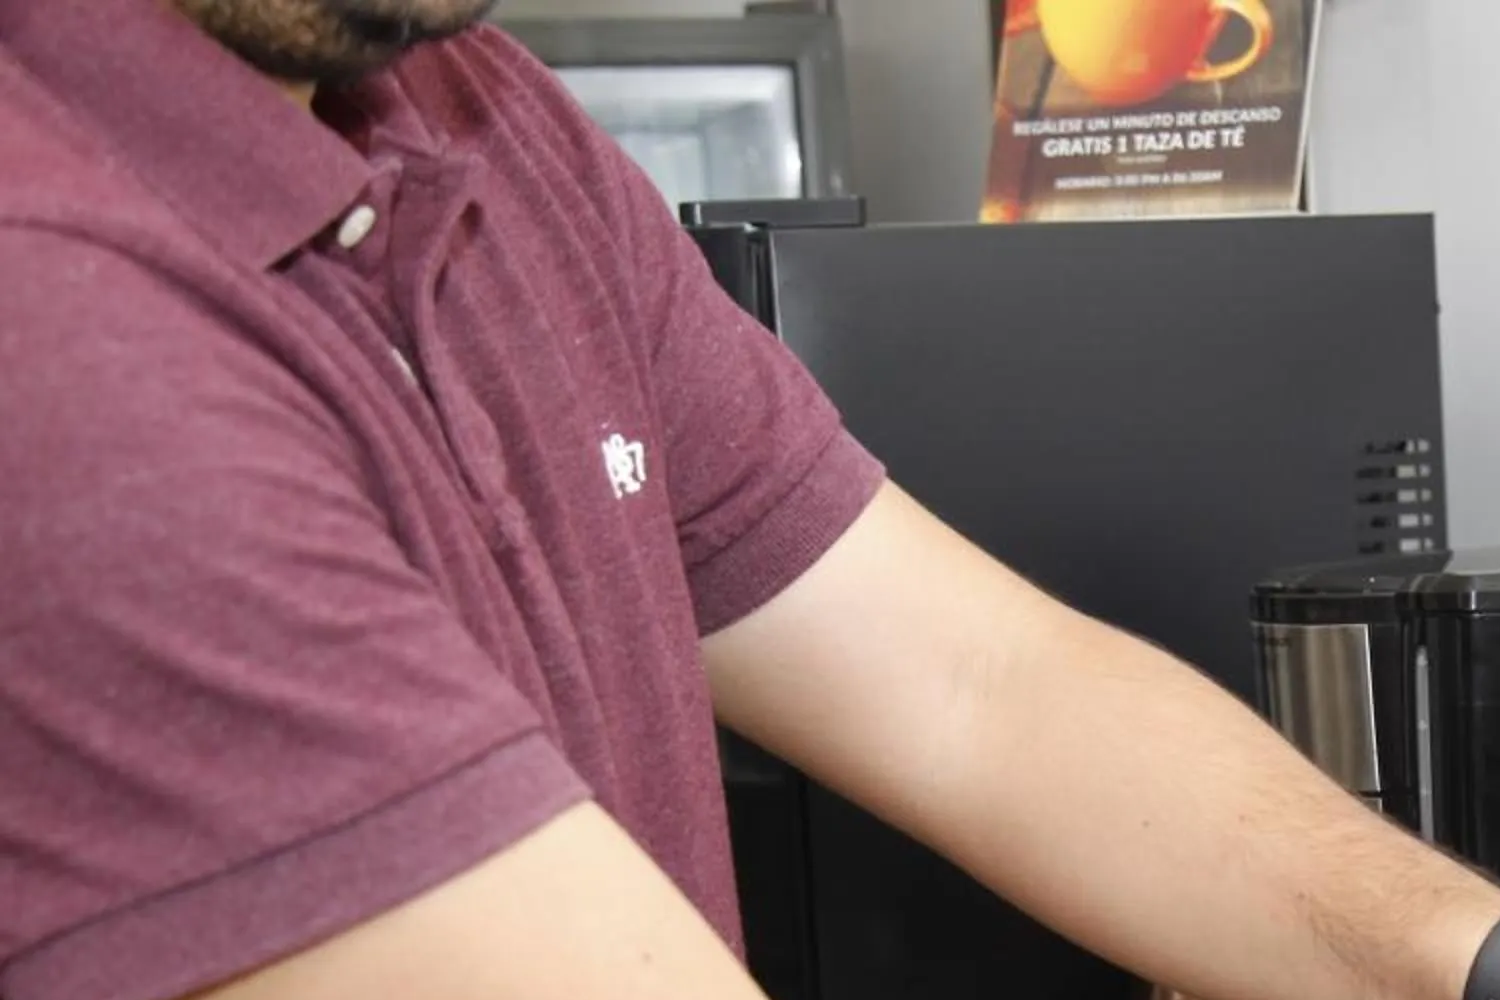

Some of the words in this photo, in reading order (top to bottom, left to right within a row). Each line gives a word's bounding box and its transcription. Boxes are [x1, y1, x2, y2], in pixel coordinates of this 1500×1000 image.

[1086, 118, 1110, 131] UN
[1112, 111, 1174, 130] MINUTO
[1176, 110, 1198, 126] DE
[1199, 106, 1282, 125] DESCANSO
[1042, 135, 1112, 158] GRATIS
[1117, 135, 1127, 153] 1
[1133, 131, 1184, 152] TAZA
[1186, 129, 1216, 149] DE
[1219, 123, 1245, 147] TÉ
